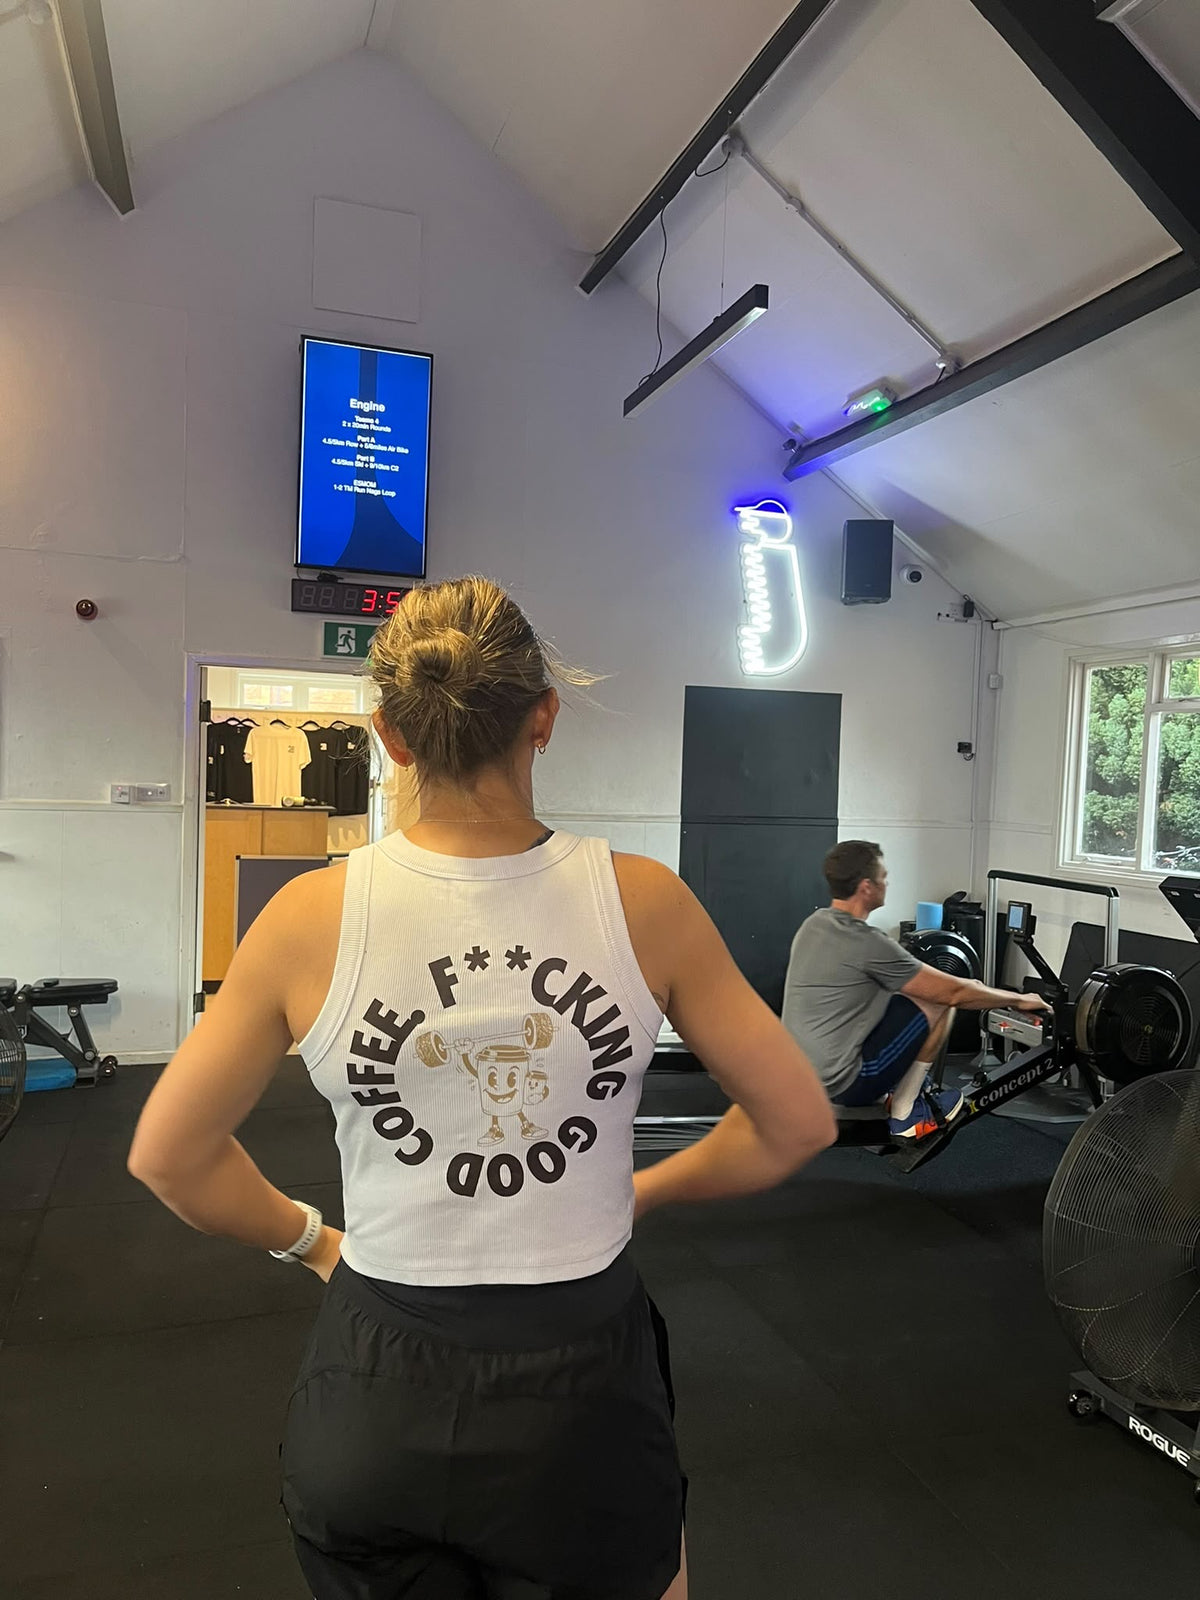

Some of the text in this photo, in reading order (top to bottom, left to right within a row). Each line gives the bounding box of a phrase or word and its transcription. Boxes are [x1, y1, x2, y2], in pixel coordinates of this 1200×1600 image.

[349, 398, 386, 412] Engine
[370, 423, 392, 432] Rounds
[357, 435, 370, 443] Part
[345, 440, 359, 448] Row
[396, 446, 410, 454] Bike
[356, 454, 369, 462] Part
[353, 486, 366, 494] Run
[381, 489, 397, 498] Loop
[979, 1065, 1044, 1108] concept
[446, 1116, 598, 1198] GOOD
[1128, 1415, 1191, 1468] ROGUE
